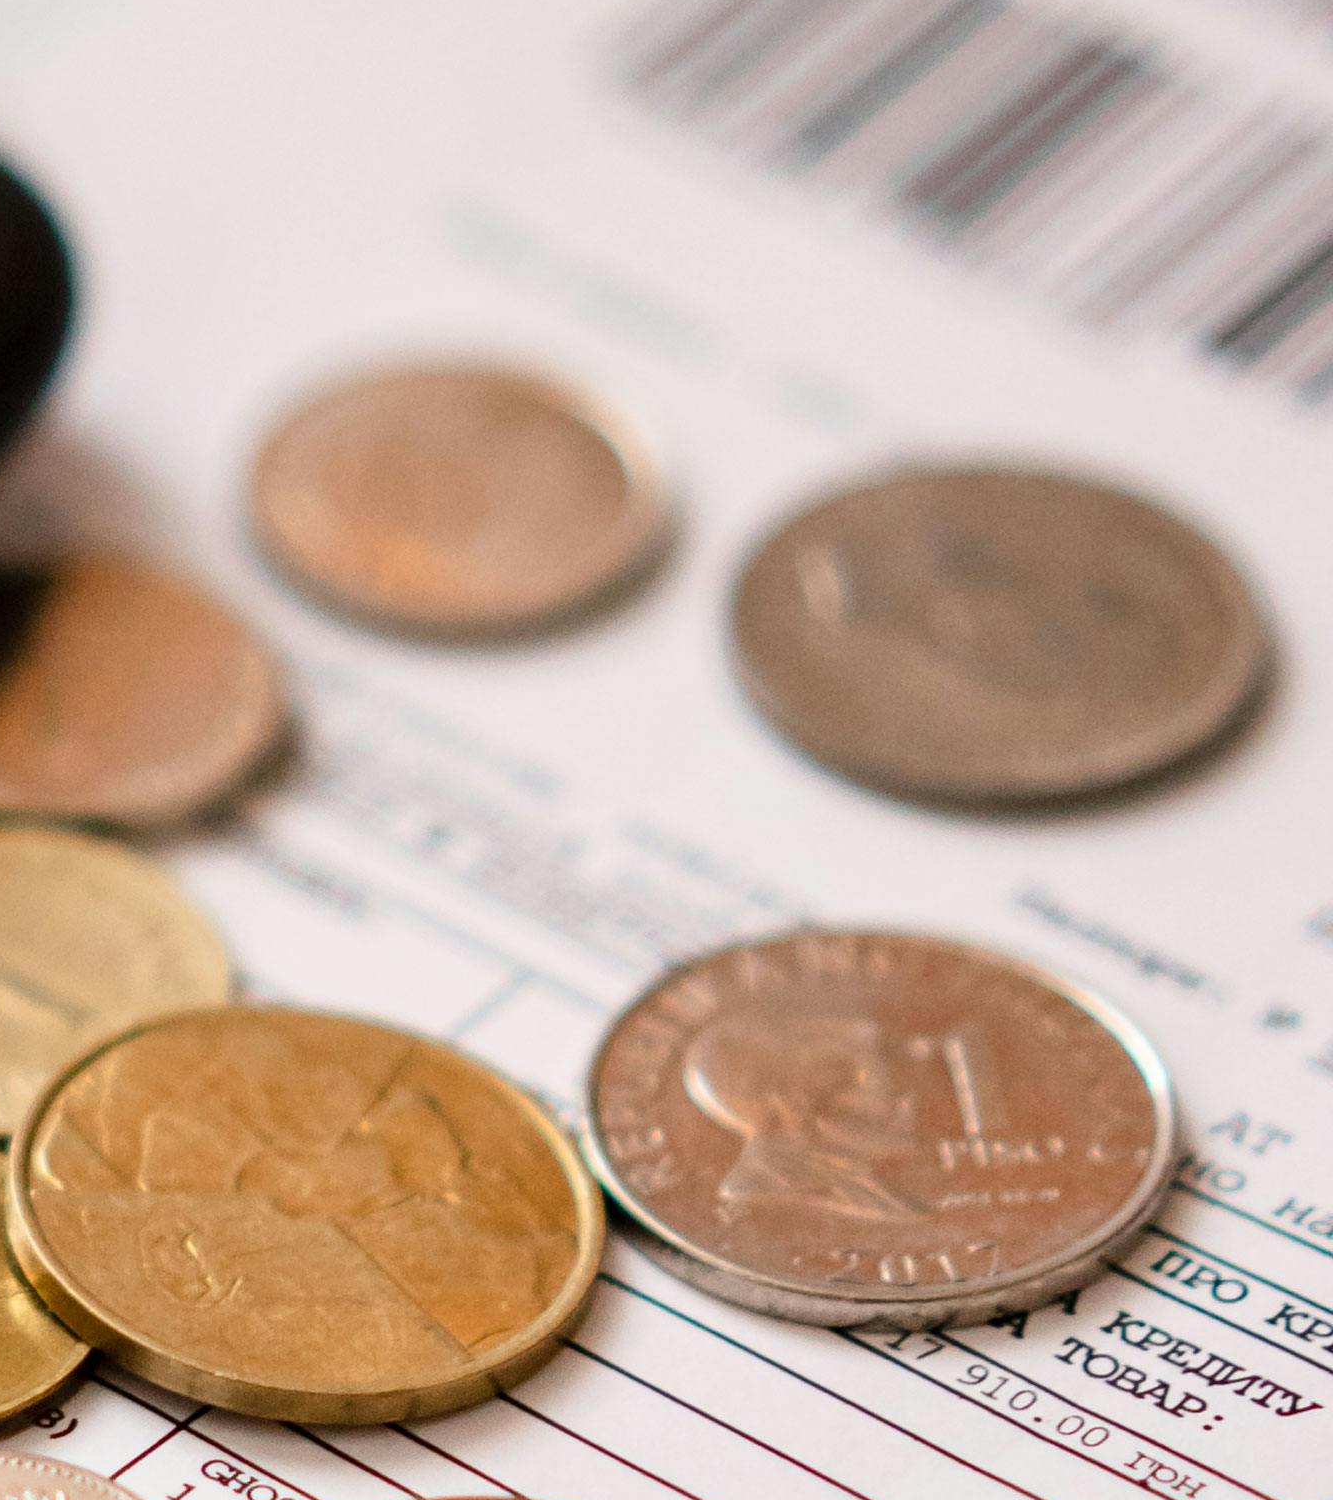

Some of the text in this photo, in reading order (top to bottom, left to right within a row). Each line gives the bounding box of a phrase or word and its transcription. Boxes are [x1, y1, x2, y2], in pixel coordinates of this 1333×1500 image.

[1151, 1250, 1333, 1353] ПРО КР
[1055, 1336, 1224, 1431] ТОВАР:
[1099, 1309, 1323, 1417] КРЕДИТУ
[956, 1363, 1111, 1450] 910.00
[1123, 1450, 1208, 1499] грн
